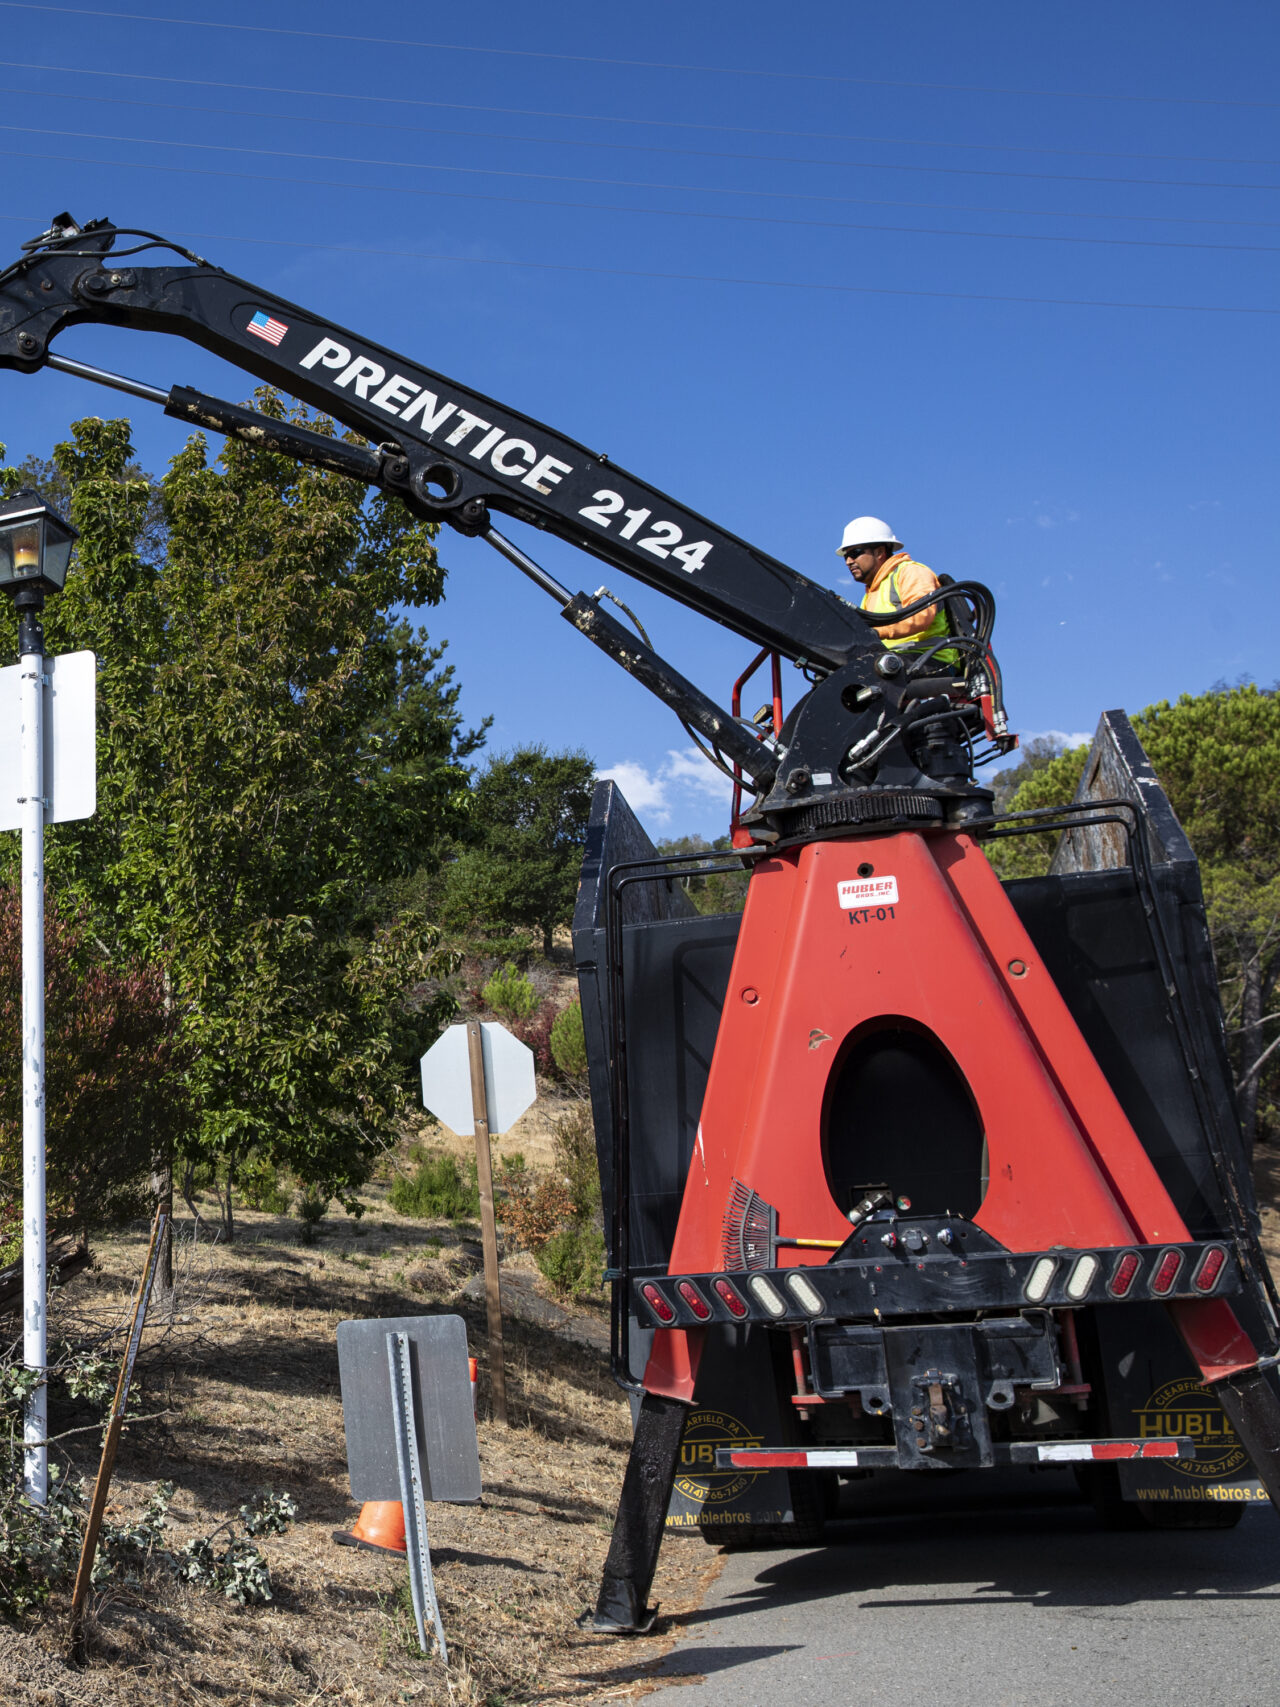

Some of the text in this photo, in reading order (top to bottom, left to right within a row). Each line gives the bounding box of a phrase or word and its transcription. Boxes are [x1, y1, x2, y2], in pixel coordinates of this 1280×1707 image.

[299, 337, 715, 574] PRENTICE 2124
[842, 881, 893, 895] HUBLER
[848, 906, 895, 925] KT-01
[1139, 1414, 1235, 1439] HUBLE
[1195, 1451, 1245, 1474] 765-7400
[678, 1479, 705, 1499] (814)
[1136, 1484, 1271, 1501] www.hublerbros.c
